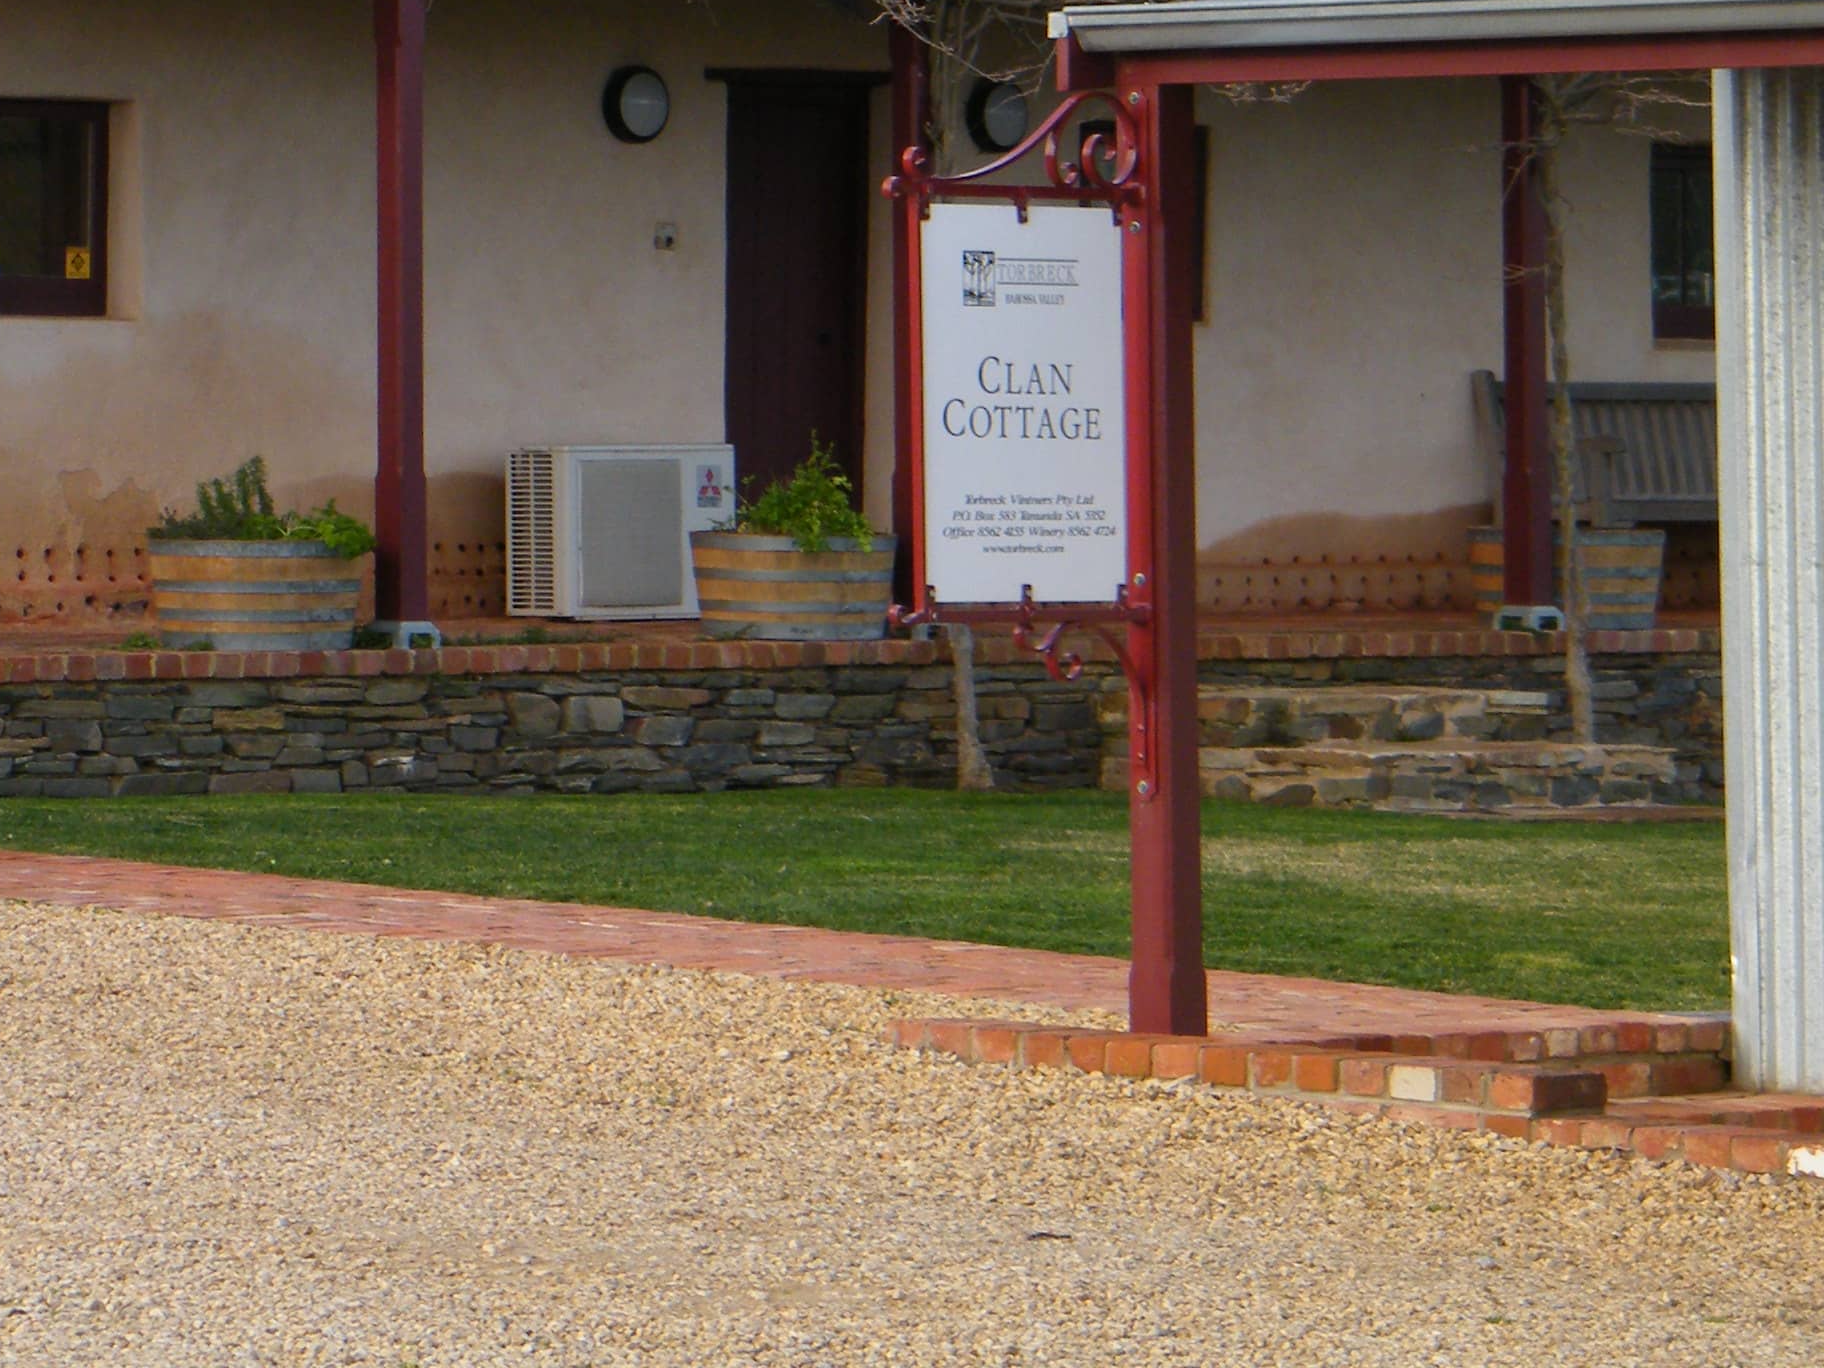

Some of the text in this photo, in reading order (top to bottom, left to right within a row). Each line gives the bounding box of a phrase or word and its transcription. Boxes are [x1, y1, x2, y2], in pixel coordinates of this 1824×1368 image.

[997, 263, 1076, 283] TORBRECK
[978, 355, 1073, 395] CLAN
[942, 398, 1102, 440] COTTAGE
[965, 494, 1095, 507] Torbreck Vintners Pty Ltd
[974, 510, 995, 521] Box
[1065, 510, 1081, 521] SA
[942, 526, 976, 539] Office
[977, 526, 1001, 537] 8562
[1028, 526, 1065, 538] Winery
